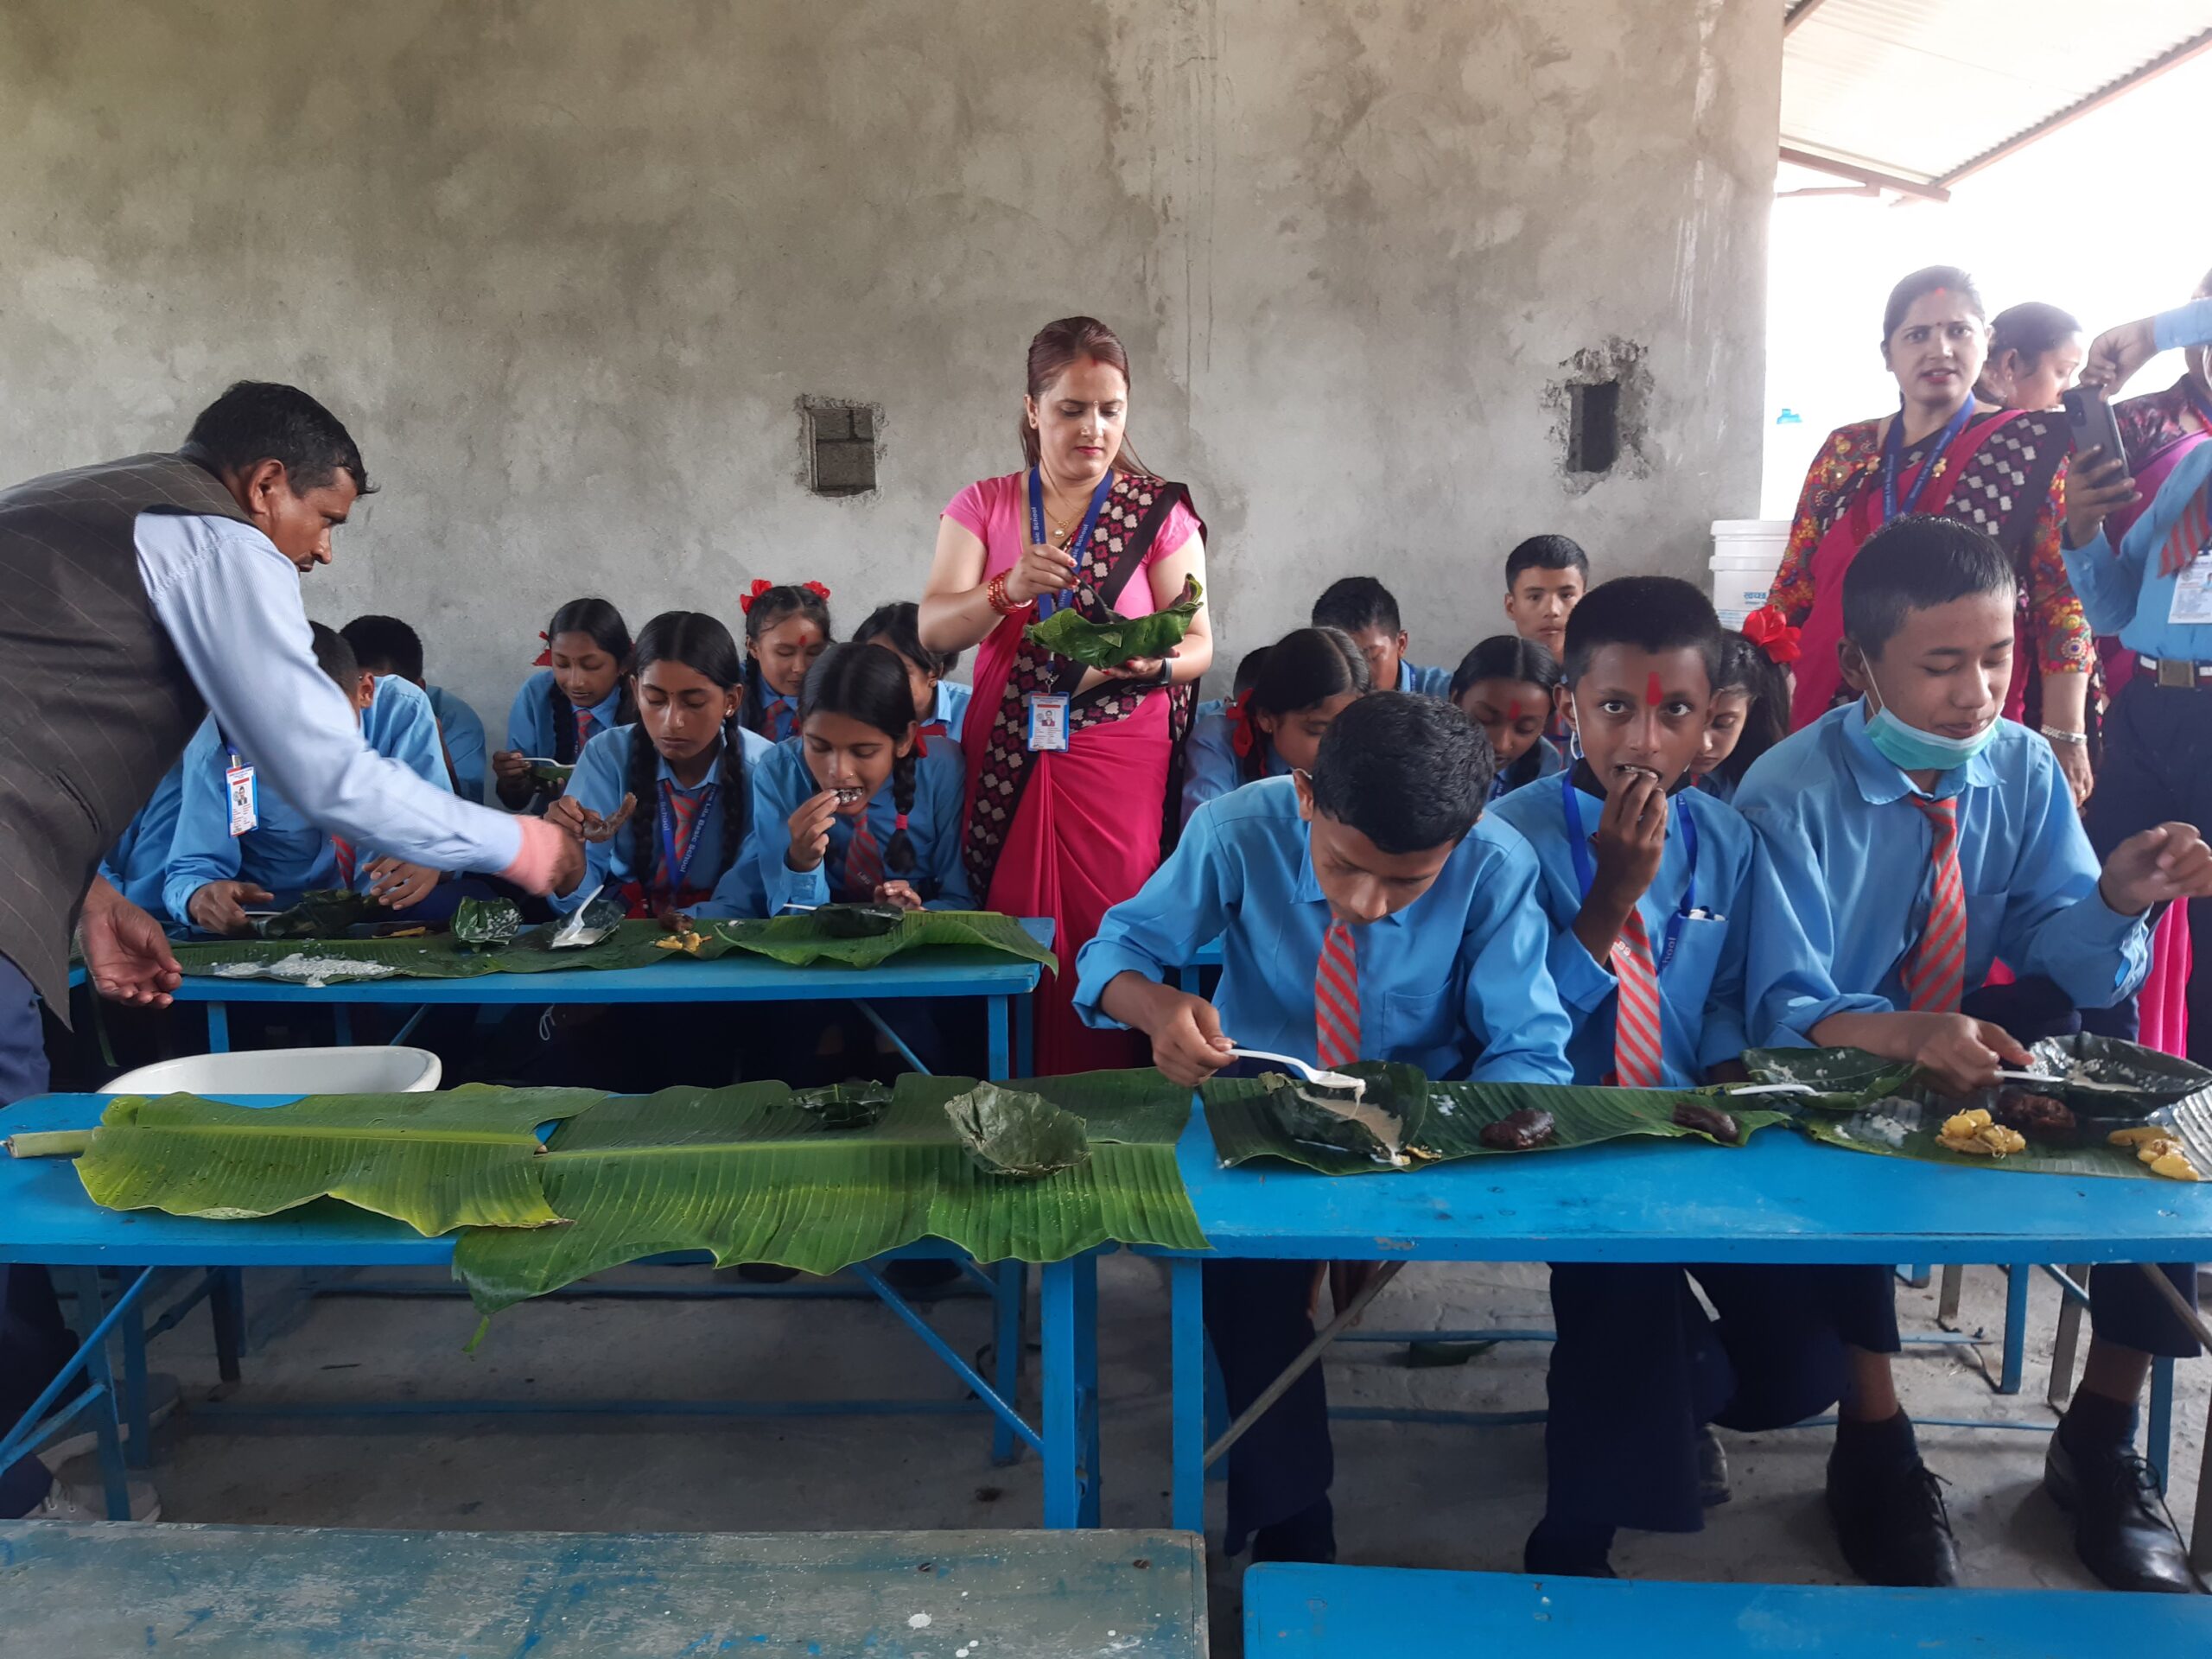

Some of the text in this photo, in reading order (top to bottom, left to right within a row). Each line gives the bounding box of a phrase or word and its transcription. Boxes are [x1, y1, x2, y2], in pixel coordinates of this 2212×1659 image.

[1031, 507, 1039, 531] School
[1077, 524, 1089, 547] School
[660, 802, 670, 831] School
[691, 819, 705, 842] Basic
[680, 844, 696, 873] School
